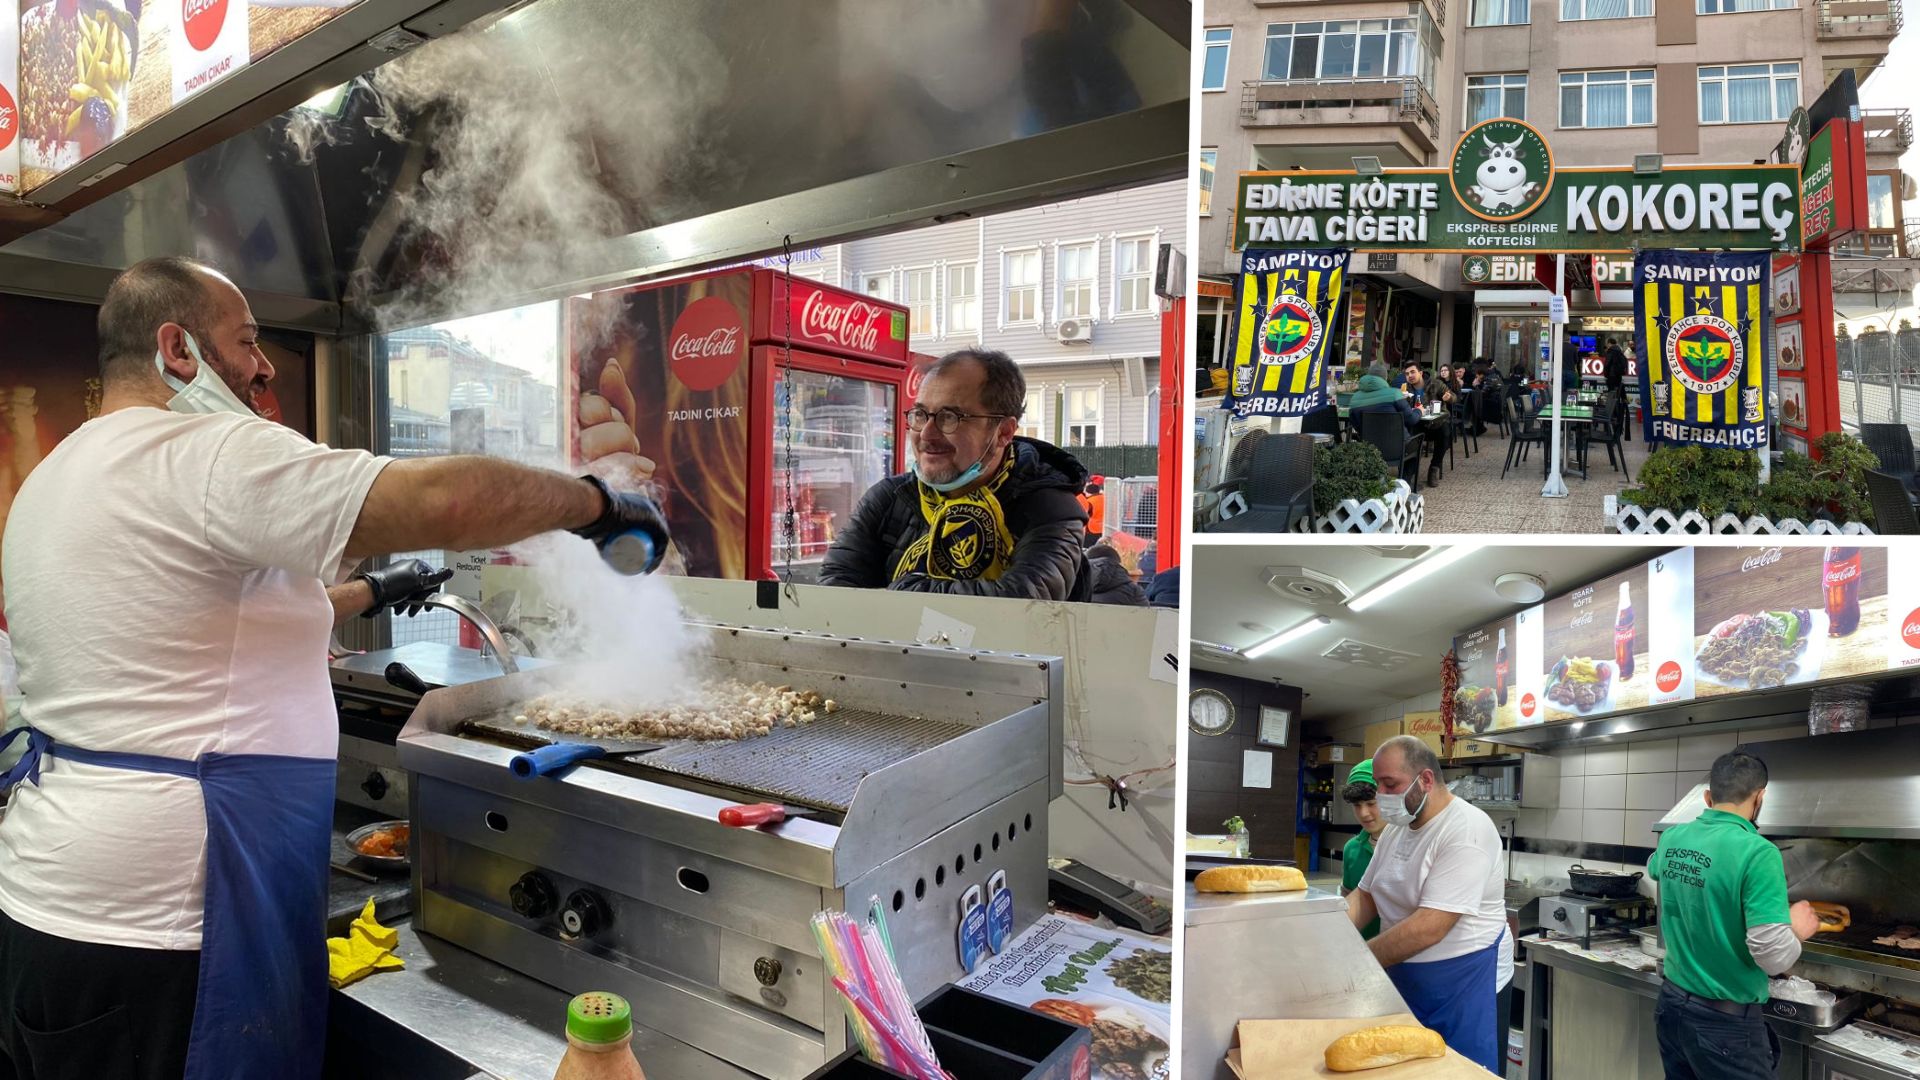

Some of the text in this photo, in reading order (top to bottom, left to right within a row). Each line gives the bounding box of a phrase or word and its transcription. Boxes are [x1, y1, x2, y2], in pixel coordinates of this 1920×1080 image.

[1245, 176, 1440, 211] EDİRNE KÖFTE
[1566, 182, 1794, 242] KOKOREÇ
[1245, 208, 1428, 243] TAVA CİĞERİ
[1447, 221, 1558, 234] EKSPRES EDİRNE
[1467, 234, 1536, 246] KÖFTECİSİ
[1245, 250, 1347, 275] ŞAMPİYON
[1644, 264, 1761, 283] ŞAMPİYON
[801, 290, 881, 352] Coca-Cola
[672, 326, 741, 360] Coca-Cola
[1667, 316, 1744, 381] FENERBAHÇE SPOR KULÜBÜ
[1263, 355, 1291, 364] 1907
[1690, 381, 1721, 392] 1907
[667, 408, 702, 421] TADINI
[1653, 420, 1767, 449] FENERBAHÇE
[1665, 848, 1711, 868] EKSPRES
[1667, 860, 1702, 876] EDİRNE
[1662, 869, 1706, 888] KÖFTECİSİ
